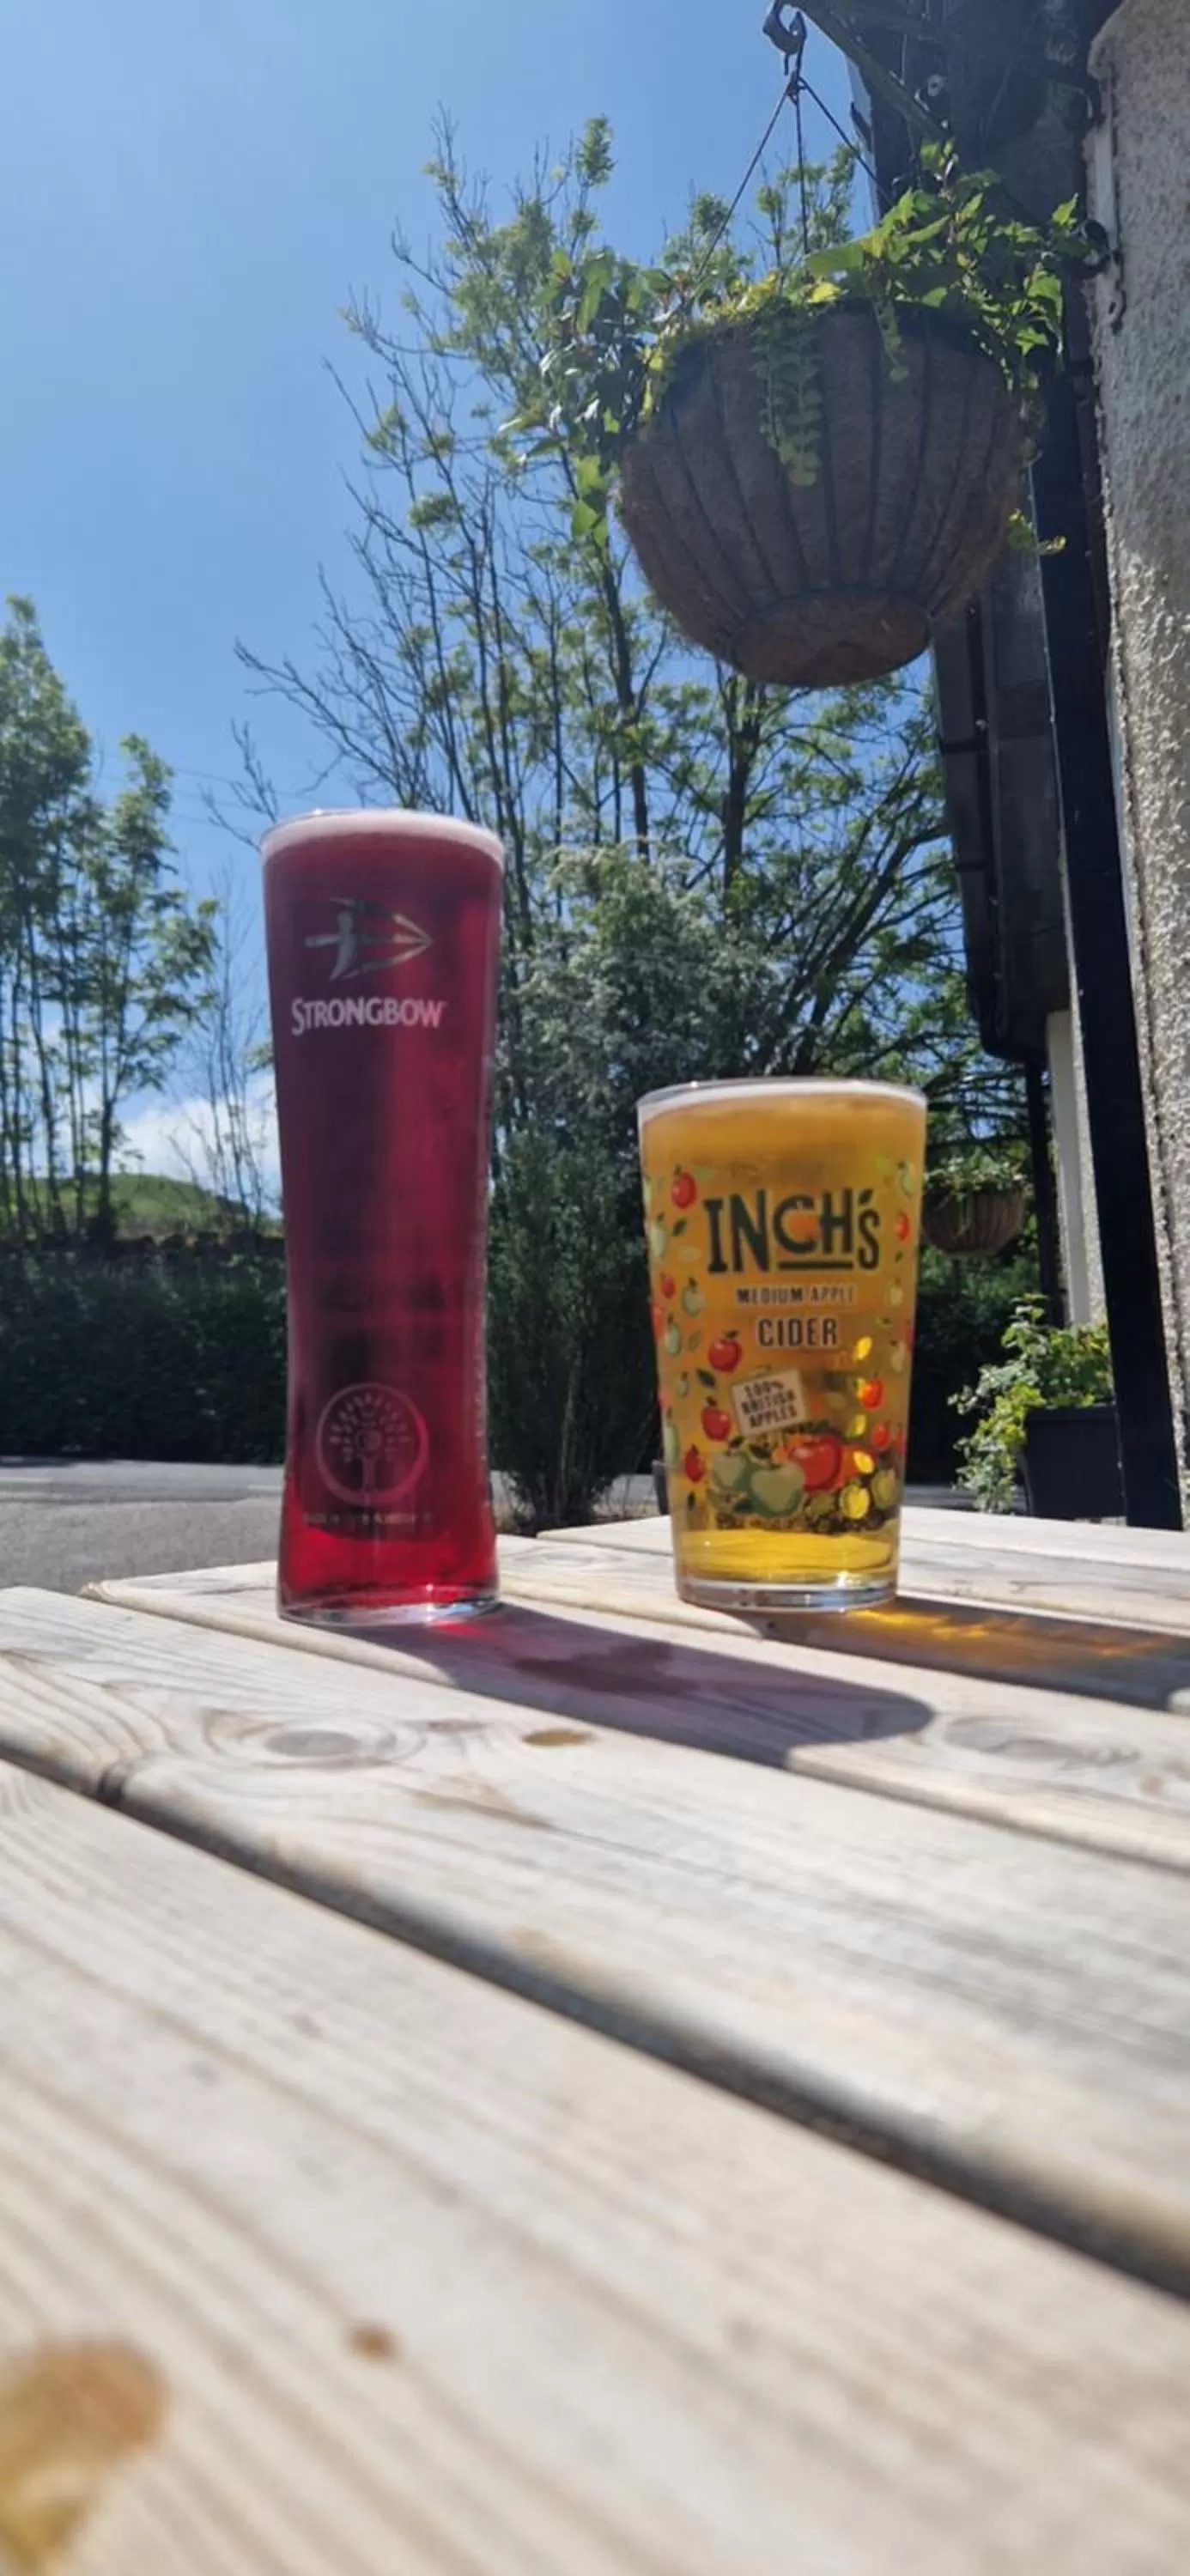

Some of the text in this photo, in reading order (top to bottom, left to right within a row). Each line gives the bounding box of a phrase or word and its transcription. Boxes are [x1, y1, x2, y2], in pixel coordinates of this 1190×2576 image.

[291, 996, 446, 1036] STRONGBOW
[703, 1188, 881, 1273] INCH'S
[737, 1285, 853, 1303] MEDIUM APPLE
[758, 1318, 836, 1346] CIDER
[741, 1389, 796, 1415] BRITISH
[750, 1404, 798, 1429] APPLES
